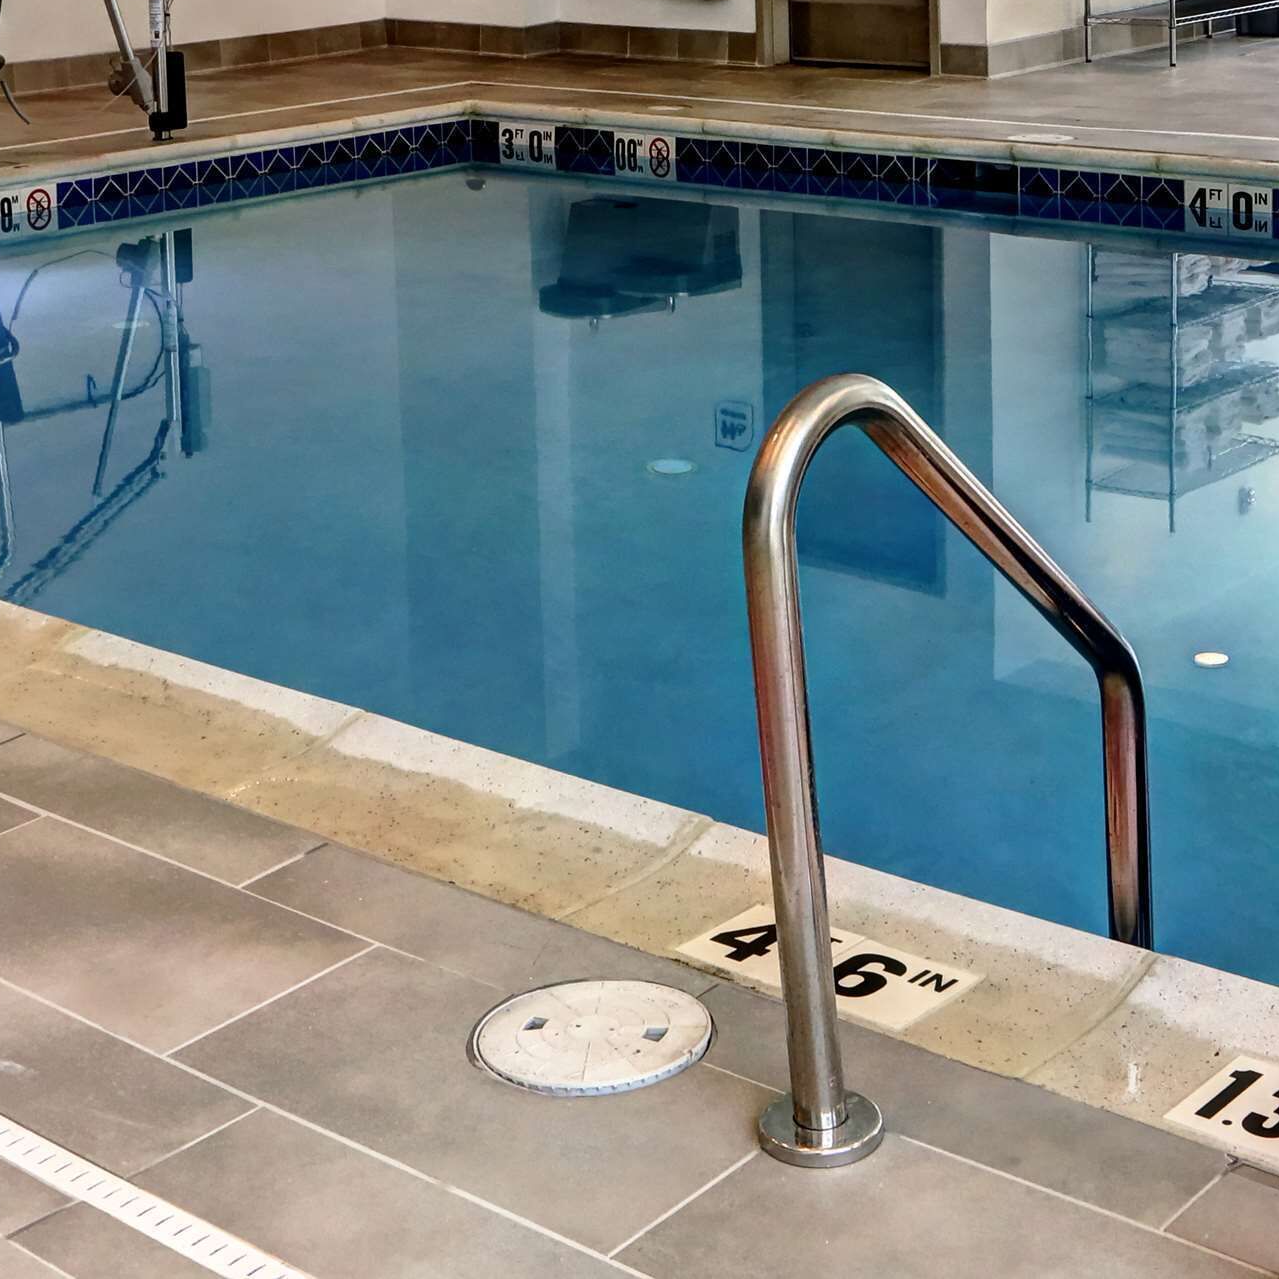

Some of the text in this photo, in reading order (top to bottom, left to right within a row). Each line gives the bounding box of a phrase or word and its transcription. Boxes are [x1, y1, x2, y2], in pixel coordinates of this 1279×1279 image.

[515, 129, 524, 139] FT
[543, 131, 552, 141] IN
[11, 196, 19, 204] M
[1208, 189, 1222, 201] FT
[1255, 193, 1267, 205] IN
[709, 924, 959, 997] 4 6 IN
